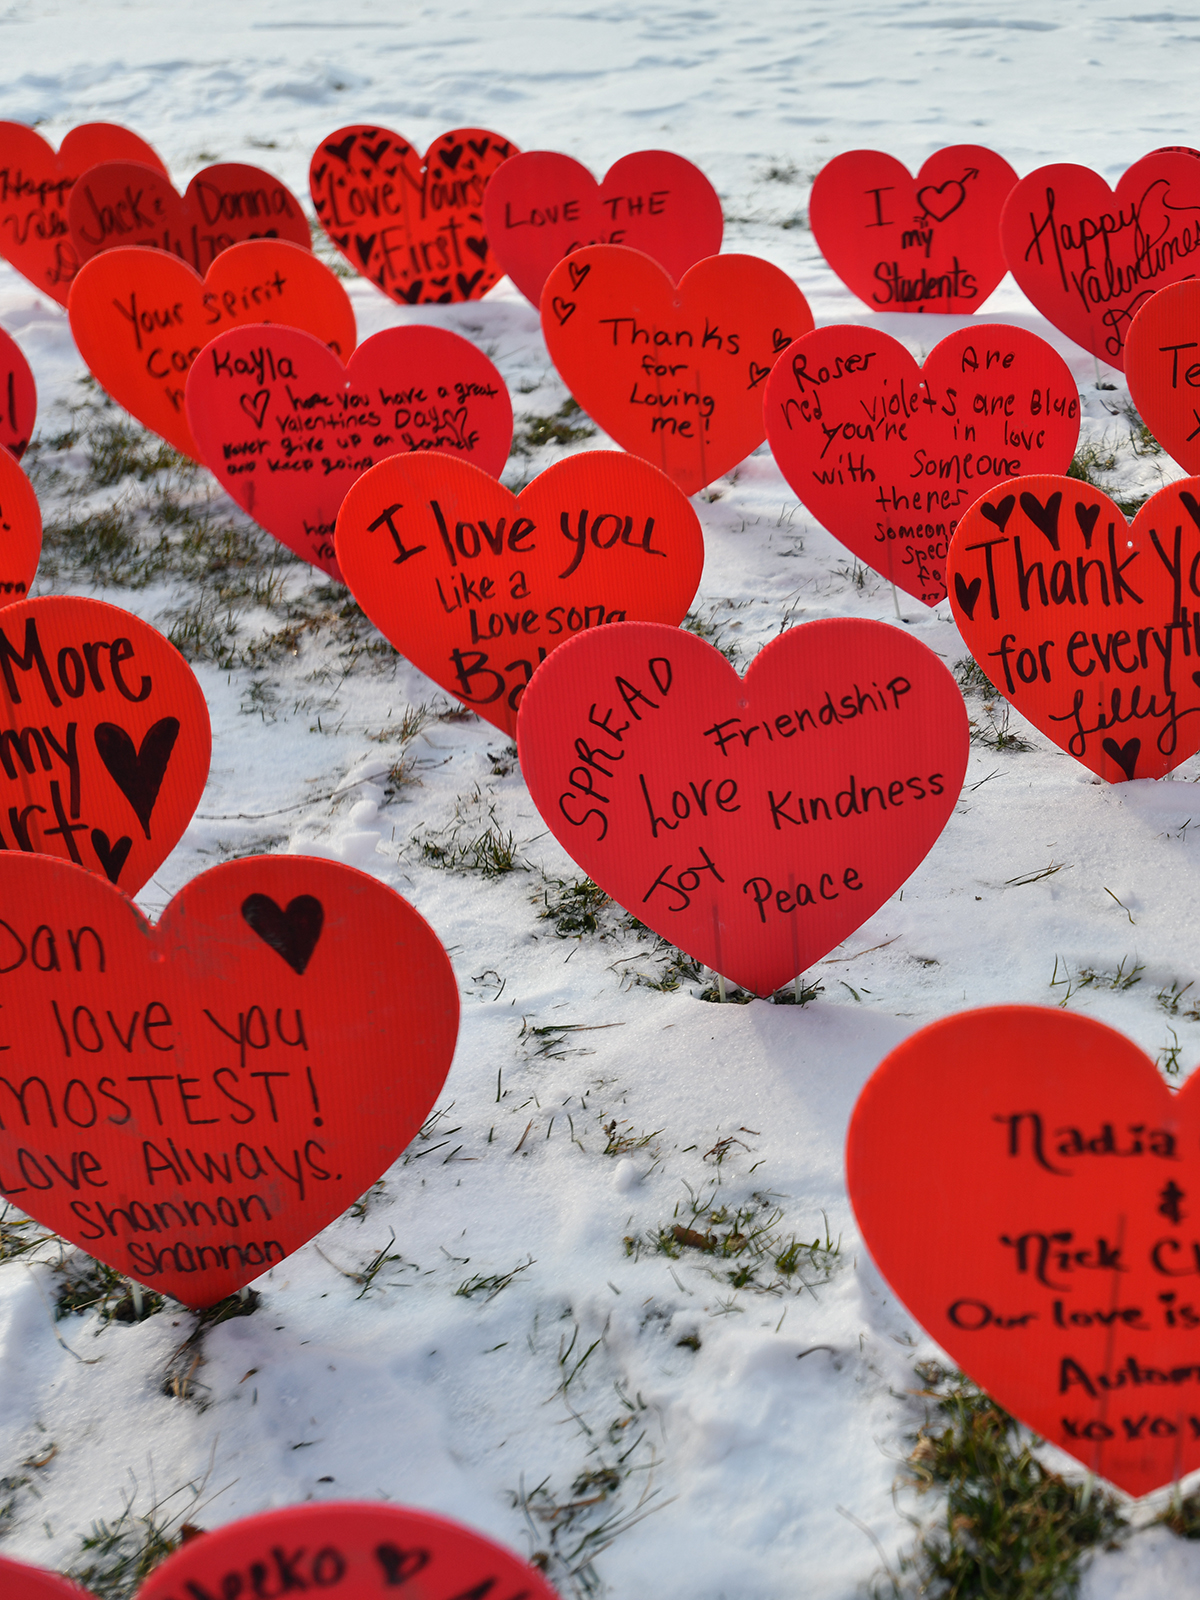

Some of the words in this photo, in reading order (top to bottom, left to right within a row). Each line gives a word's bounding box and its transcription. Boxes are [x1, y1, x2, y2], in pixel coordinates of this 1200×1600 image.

[196, 180, 294, 228] Donna
[327, 168, 401, 230] Love
[604, 191, 671, 220] THE
[864, 187, 895, 228] I
[380, 216, 465, 280] First
[902, 228, 933, 258] my
[1024, 180, 1170, 293] Happy
[872, 256, 978, 304] Students
[112, 291, 183, 350] Your
[599, 316, 740, 355] Thanks
[211, 347, 298, 386] Kayla
[640, 354, 689, 377] for
[792, 353, 877, 393] Roses
[962, 345, 1016, 373] Are
[337, 391, 370, 410] you
[379, 388, 428, 406] have
[437, 386, 449, 398] a
[454, 382, 499, 403] great
[630, 382, 715, 418] Loving
[781, 390, 823, 430] red
[973, 392, 1016, 417] are
[1030, 387, 1078, 420] Blue
[395, 407, 444, 432] Day
[954, 419, 976, 442] in
[1004, 420, 1046, 451] love
[267, 457, 314, 473] keep
[281, 434, 325, 458] give
[337, 433, 362, 449] up
[373, 434, 394, 447] on
[812, 451, 877, 486] with
[367, 503, 428, 565] I
[429, 500, 537, 567] love
[558, 509, 667, 579] you
[509, 570, 531, 599] a
[965, 522, 1144, 621] Thank
[988, 633, 1055, 695] for
[704, 676, 912, 756] Friendship
[558, 657, 673, 842] SPREAD
[640, 774, 741, 838] Love
[767, 771, 945, 831] Kindness
[742, 866, 864, 924] Peace
[51, 1000, 174, 1057] love
[203, 1004, 309, 1068] you
[993, 1110, 1180, 1176] Nadia
[947, 1298, 1038, 1331] Our
[1053, 1299, 1151, 1330] love
